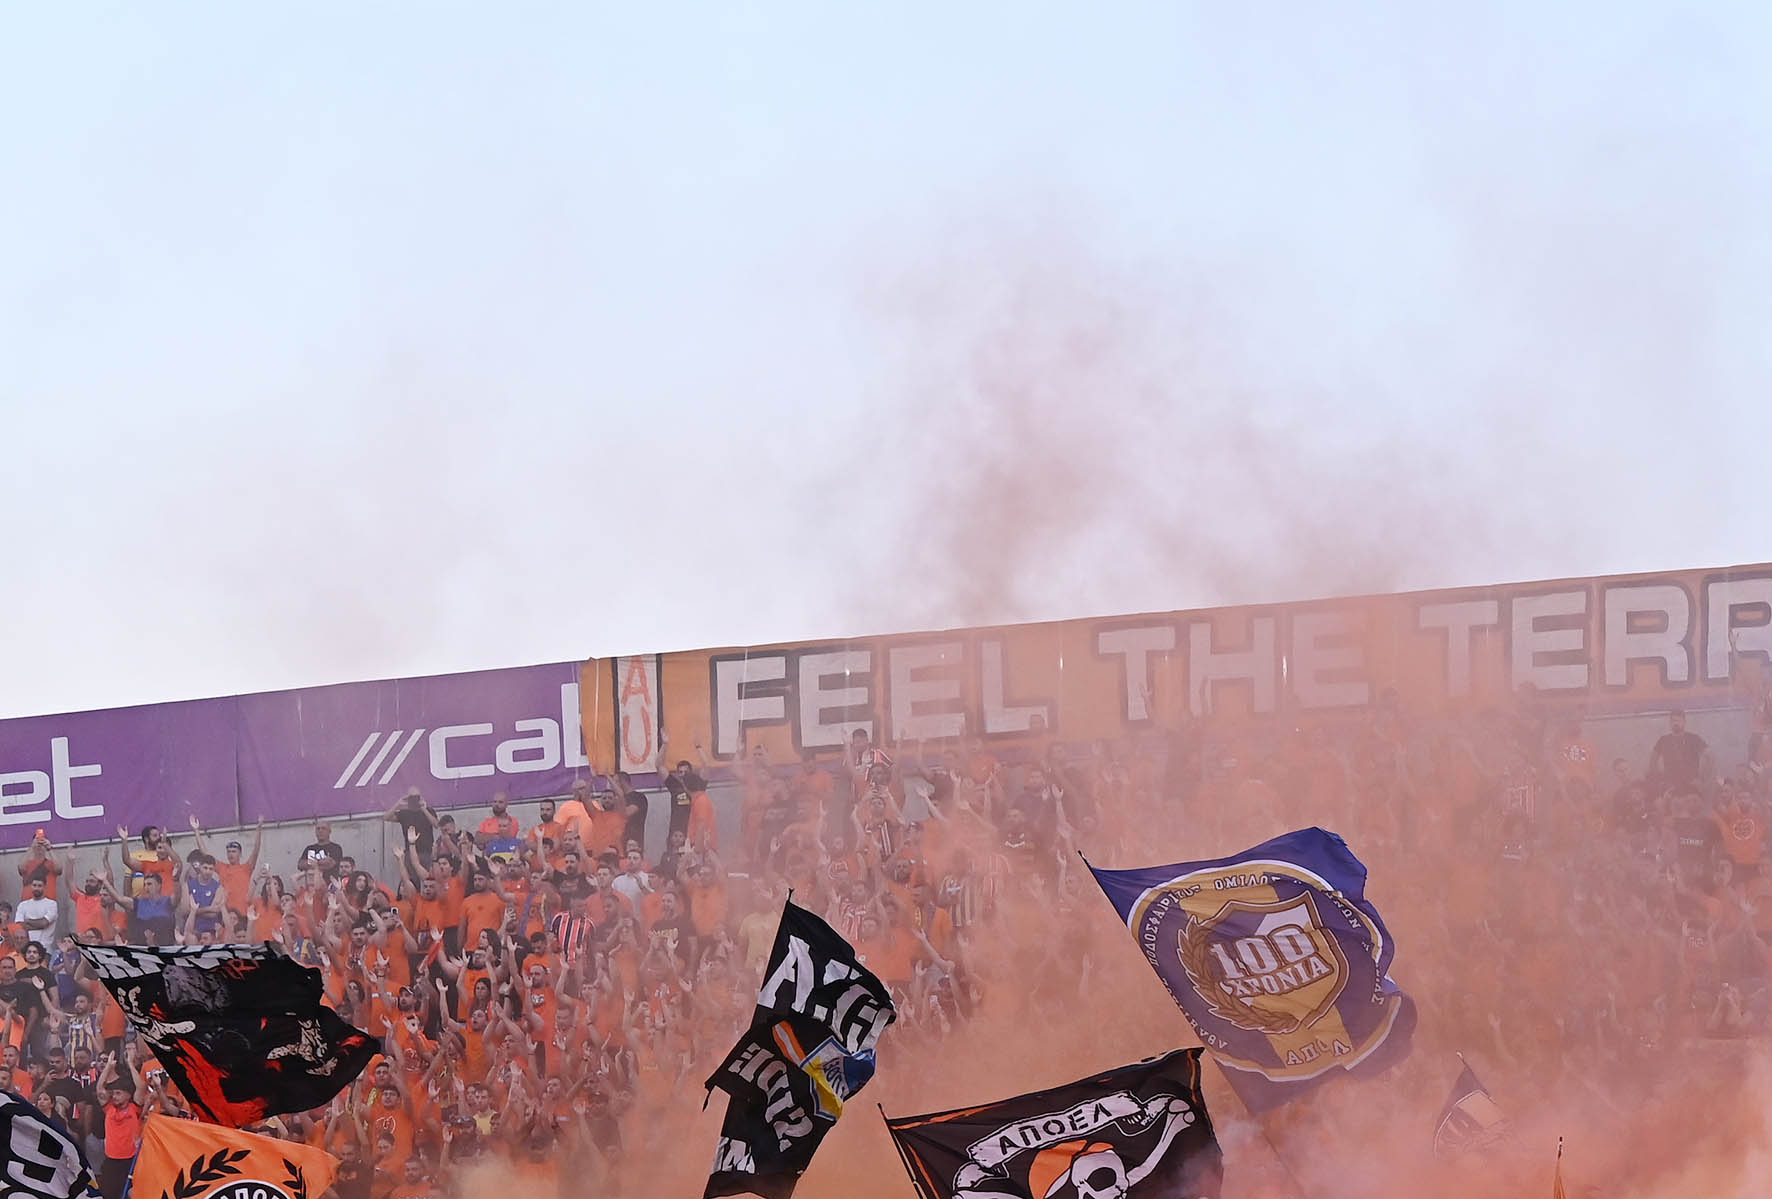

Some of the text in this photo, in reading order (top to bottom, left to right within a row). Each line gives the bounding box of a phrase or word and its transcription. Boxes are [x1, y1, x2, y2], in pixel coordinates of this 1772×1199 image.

[712, 634, 1050, 760] FEEL
[1094, 608, 1372, 724] THE
[1209, 925, 1318, 981] 100
[999, 1101, 1113, 1156] ΑΠΟΕΛ
